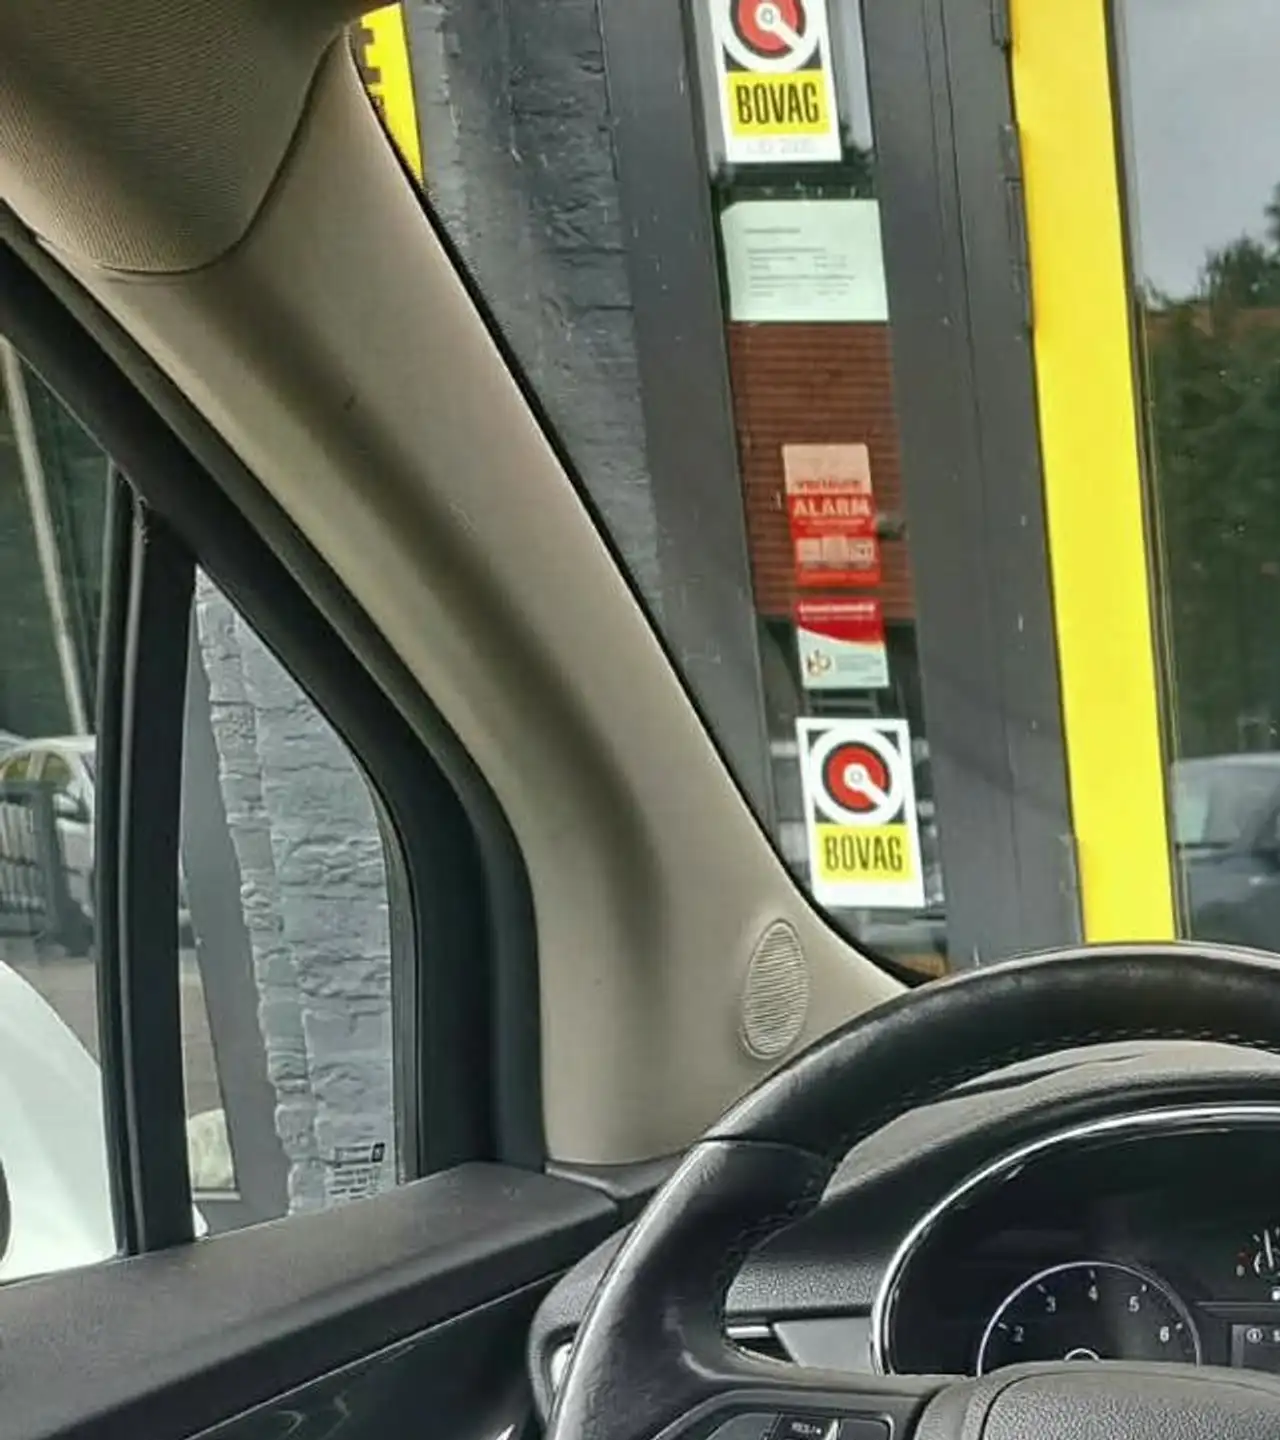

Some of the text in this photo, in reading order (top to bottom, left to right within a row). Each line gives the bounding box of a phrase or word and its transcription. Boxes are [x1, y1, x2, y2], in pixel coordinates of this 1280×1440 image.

[735, 81, 820, 125] BOVAG
[793, 497, 871, 517] ALARM
[823, 835, 904, 872] BOVAG
[1088, 1285, 1099, 1301] 4
[1045, 1295, 1057, 1313] 3
[1127, 1295, 1141, 1313] 5
[1013, 1325, 1025, 1342] 2
[1158, 1326, 1170, 1342] 6
